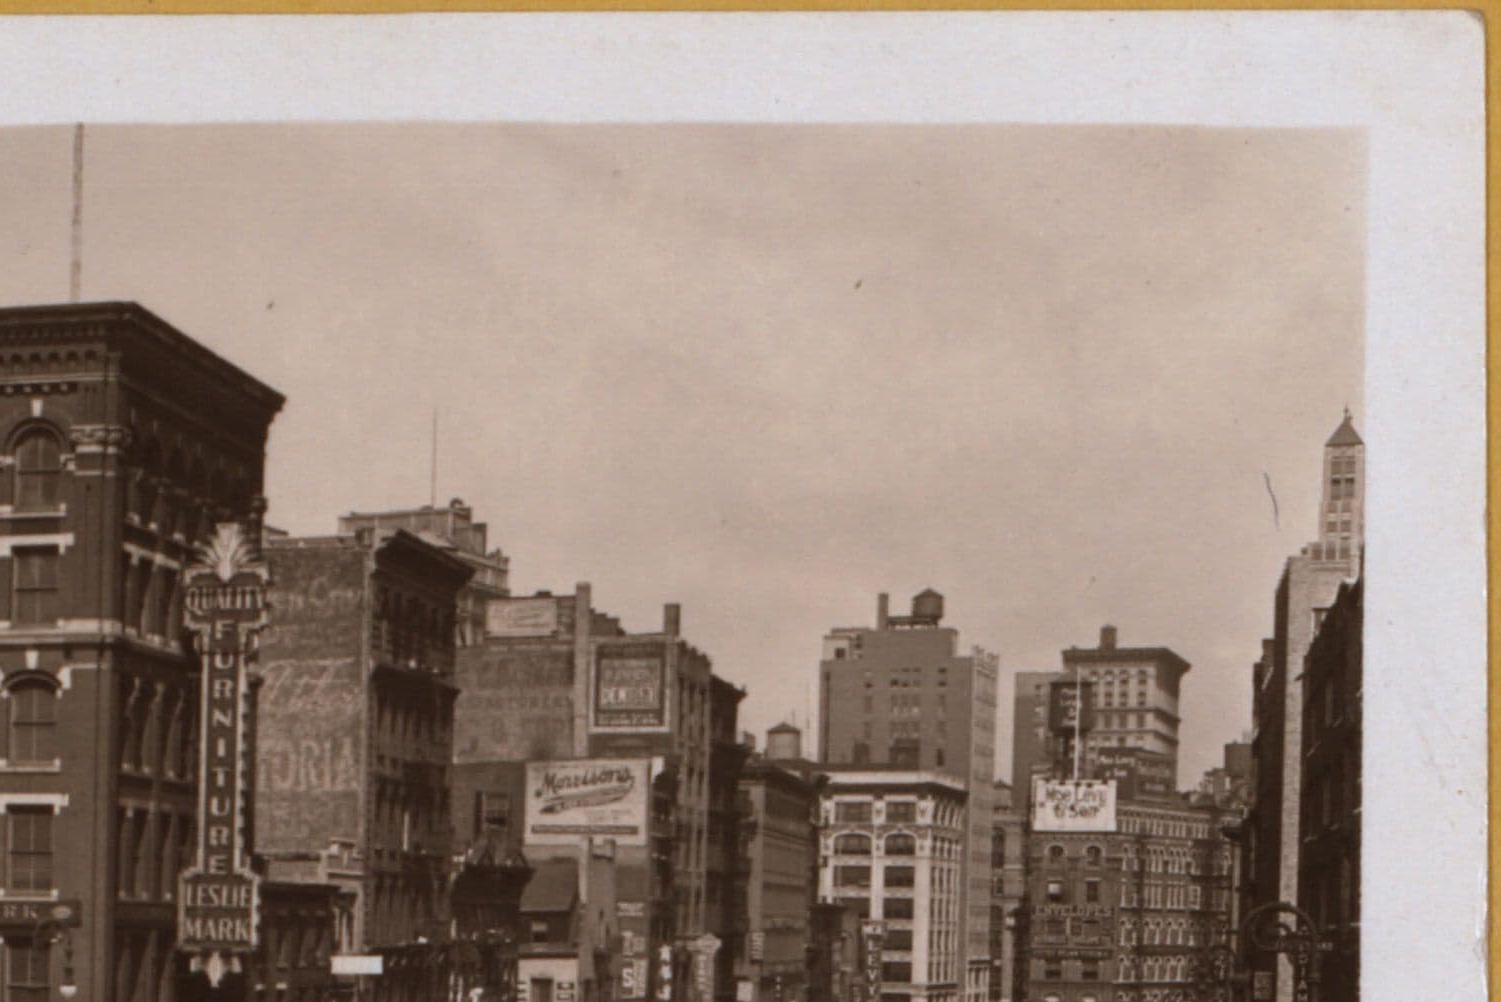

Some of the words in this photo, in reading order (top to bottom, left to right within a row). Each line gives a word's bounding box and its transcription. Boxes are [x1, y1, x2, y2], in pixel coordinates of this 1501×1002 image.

[186, 586, 263, 616] QUALITY
[209, 619, 236, 876] FURNITURE
[185, 882, 252, 908] LESLIE
[1035, 904, 1112, 917] ENVELOPES
[183, 917, 250, 945] MARK
